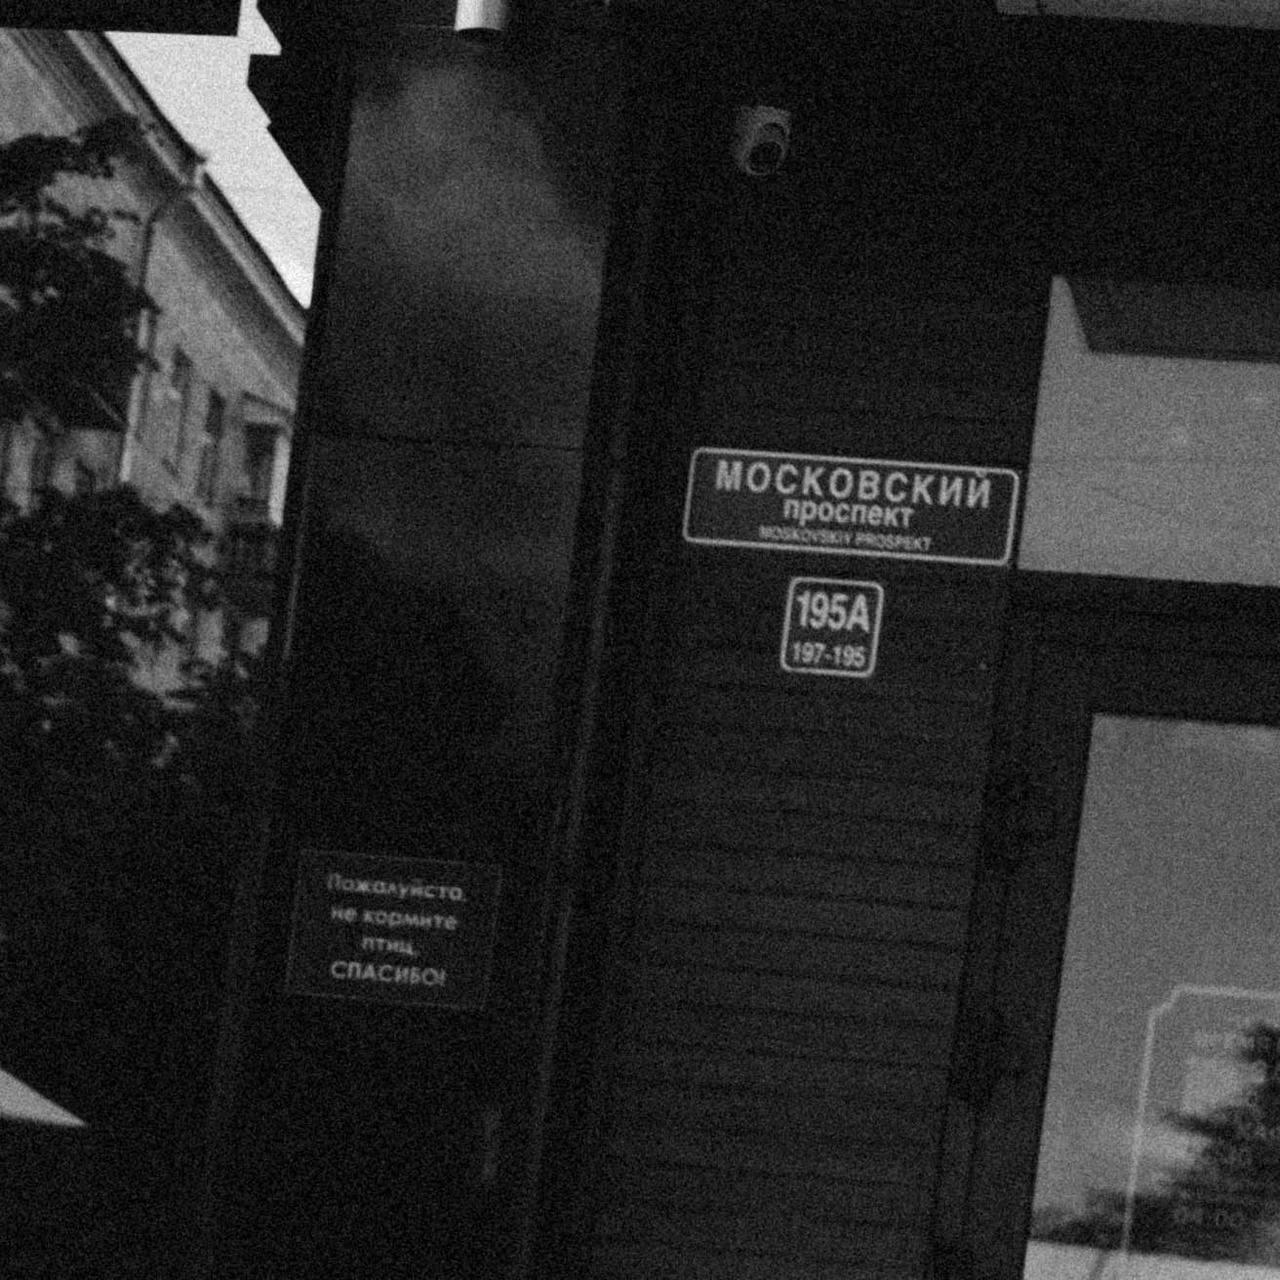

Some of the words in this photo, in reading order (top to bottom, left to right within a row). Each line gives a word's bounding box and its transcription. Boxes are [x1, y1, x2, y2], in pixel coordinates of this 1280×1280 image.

[715, 459, 992, 508] МОСКОВСКИЙ
[783, 499, 915, 528] проспект
[793, 641, 866, 667] 197-195
[330, 905, 358, 922] не
[362, 908, 458, 930] кормите
